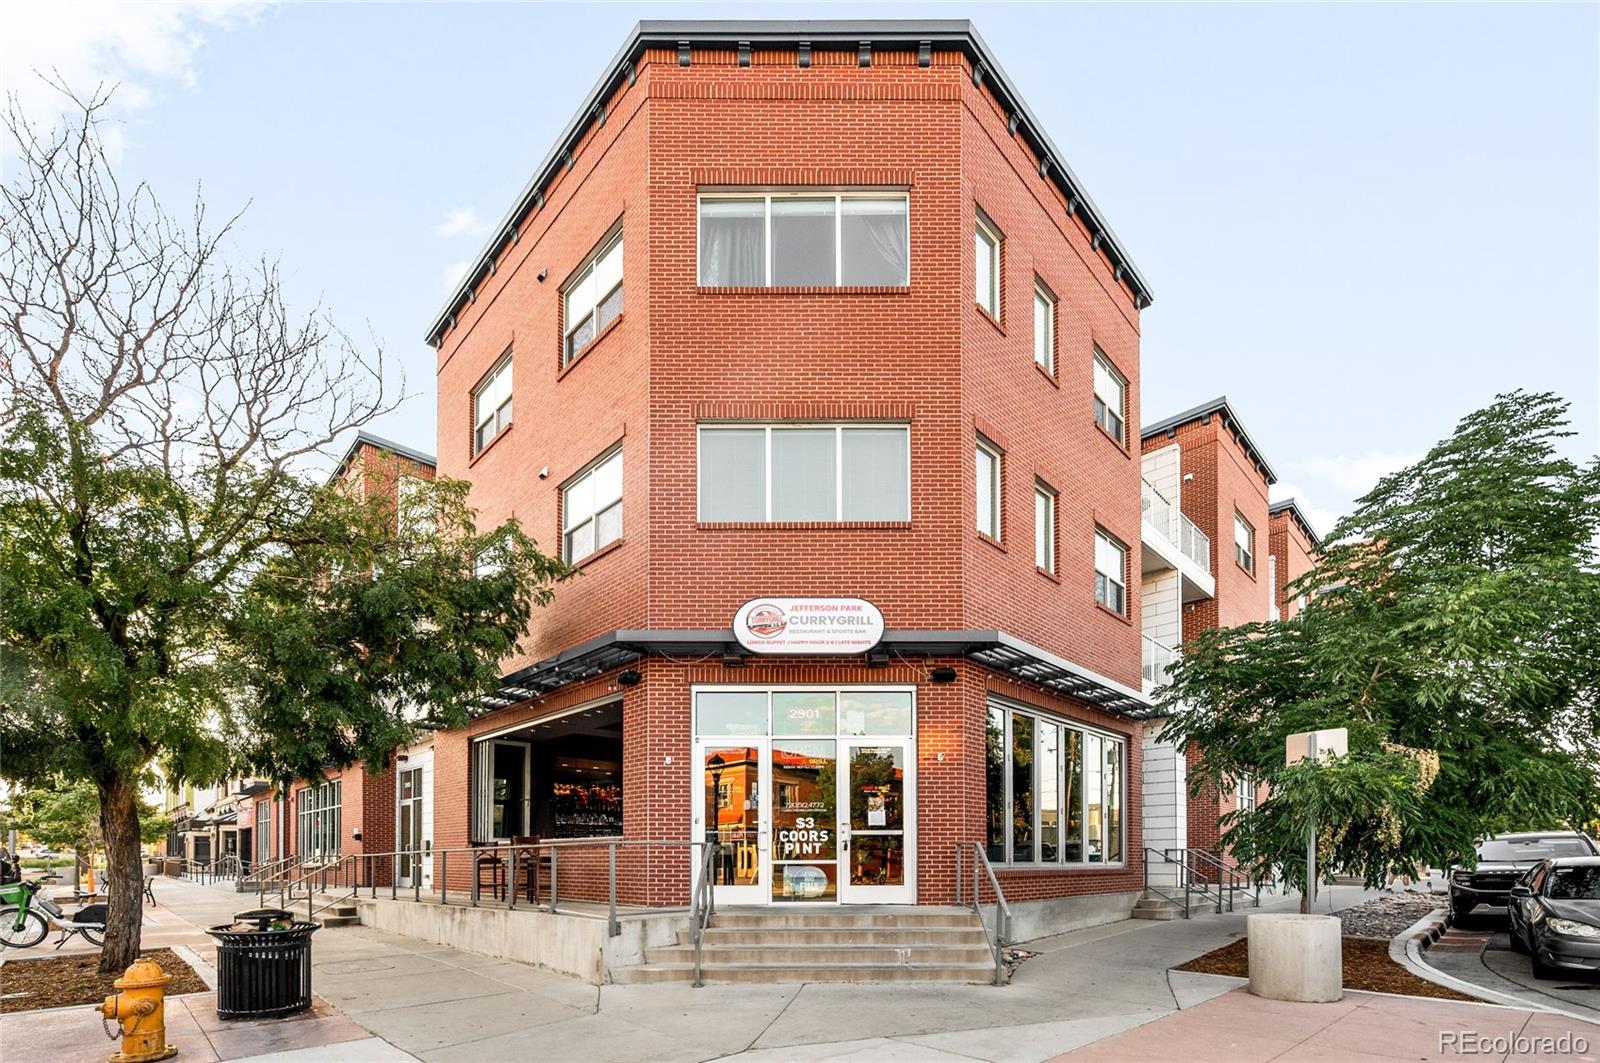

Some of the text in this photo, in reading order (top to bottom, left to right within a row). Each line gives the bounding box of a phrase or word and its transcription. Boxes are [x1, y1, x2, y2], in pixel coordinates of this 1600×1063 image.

[789, 615, 873, 626] CURRYGRILL
[789, 708, 820, 719] 2901
[779, 830, 829, 842] COORS
[784, 842, 822, 854] PINT
